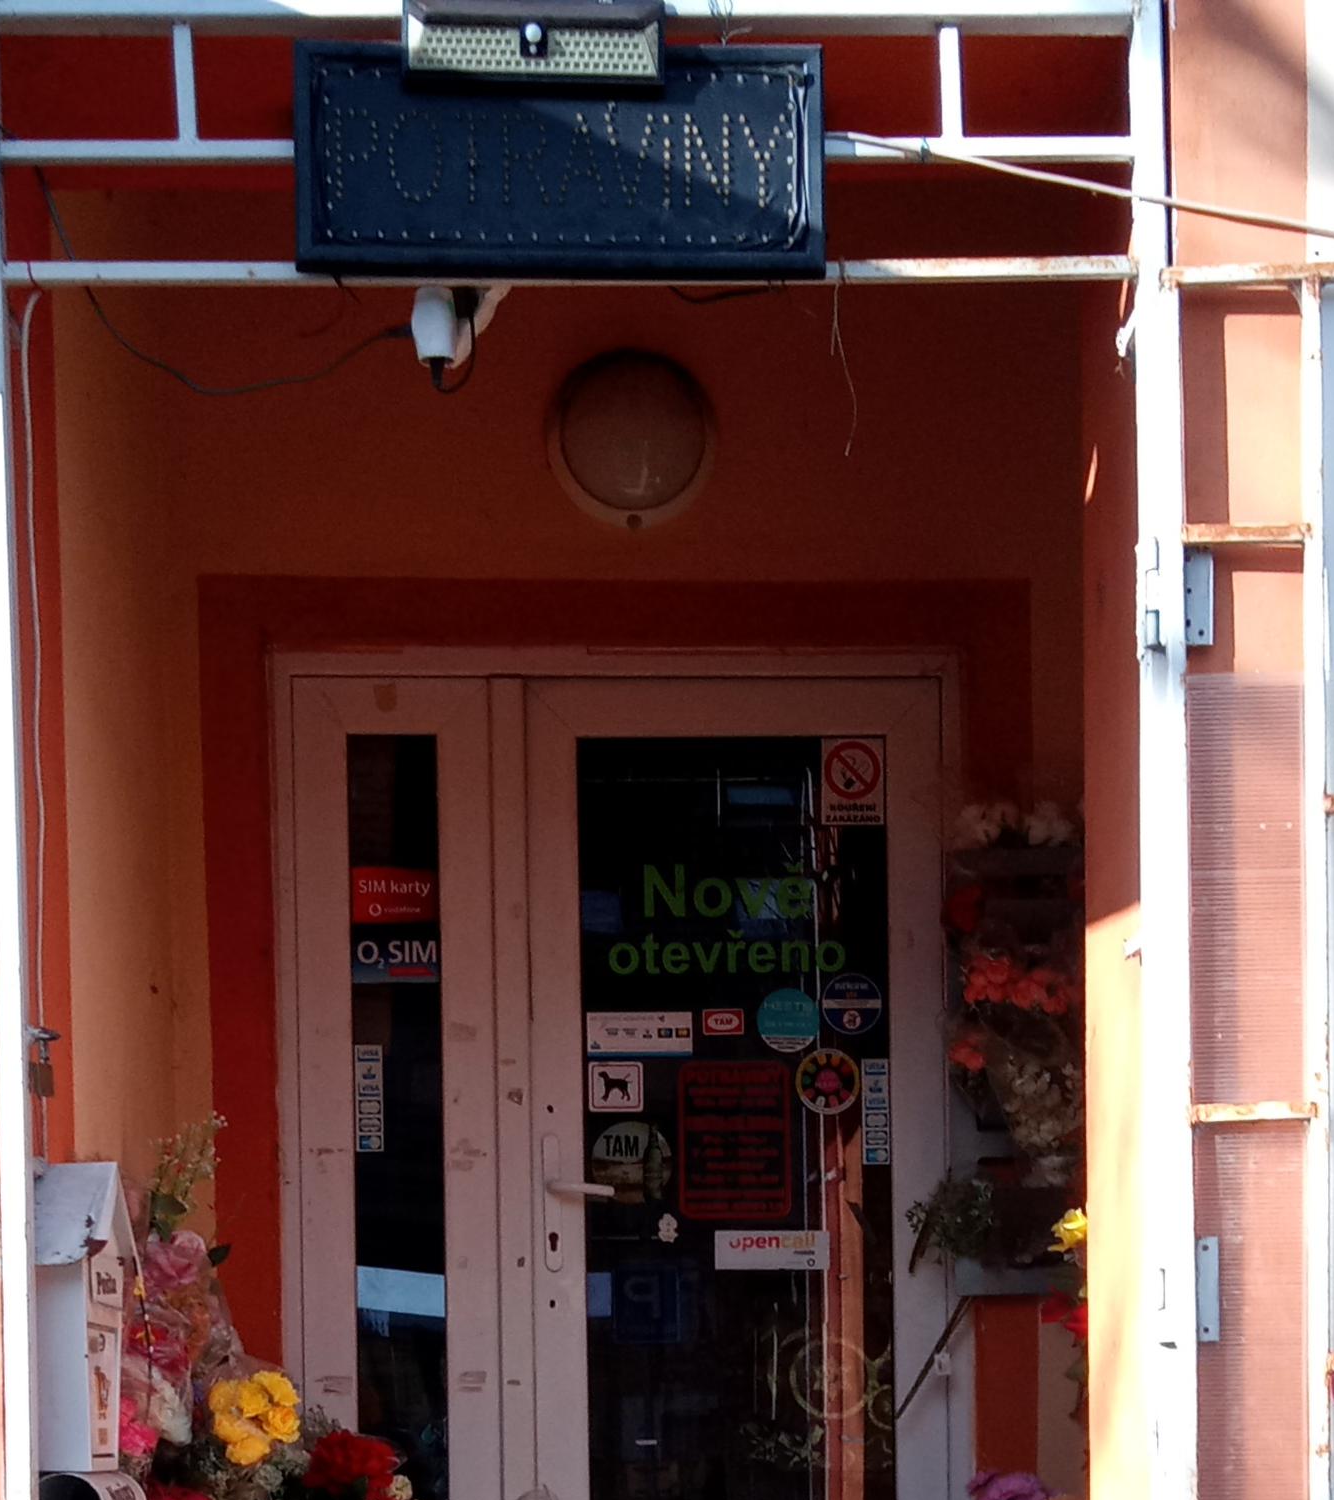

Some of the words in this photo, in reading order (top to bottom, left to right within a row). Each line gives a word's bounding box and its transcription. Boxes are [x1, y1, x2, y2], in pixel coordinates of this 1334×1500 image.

[334, 110, 787, 208] POTRAVINY
[358, 879, 386, 894] SIM
[390, 879, 431, 897] karty
[643, 863, 814, 919] Nově
[388, 940, 437, 964] SIM
[608, 930, 847, 976] otevřeno
[713, 1017, 733, 1026] TAM
[602, 1134, 639, 1157] TAM
